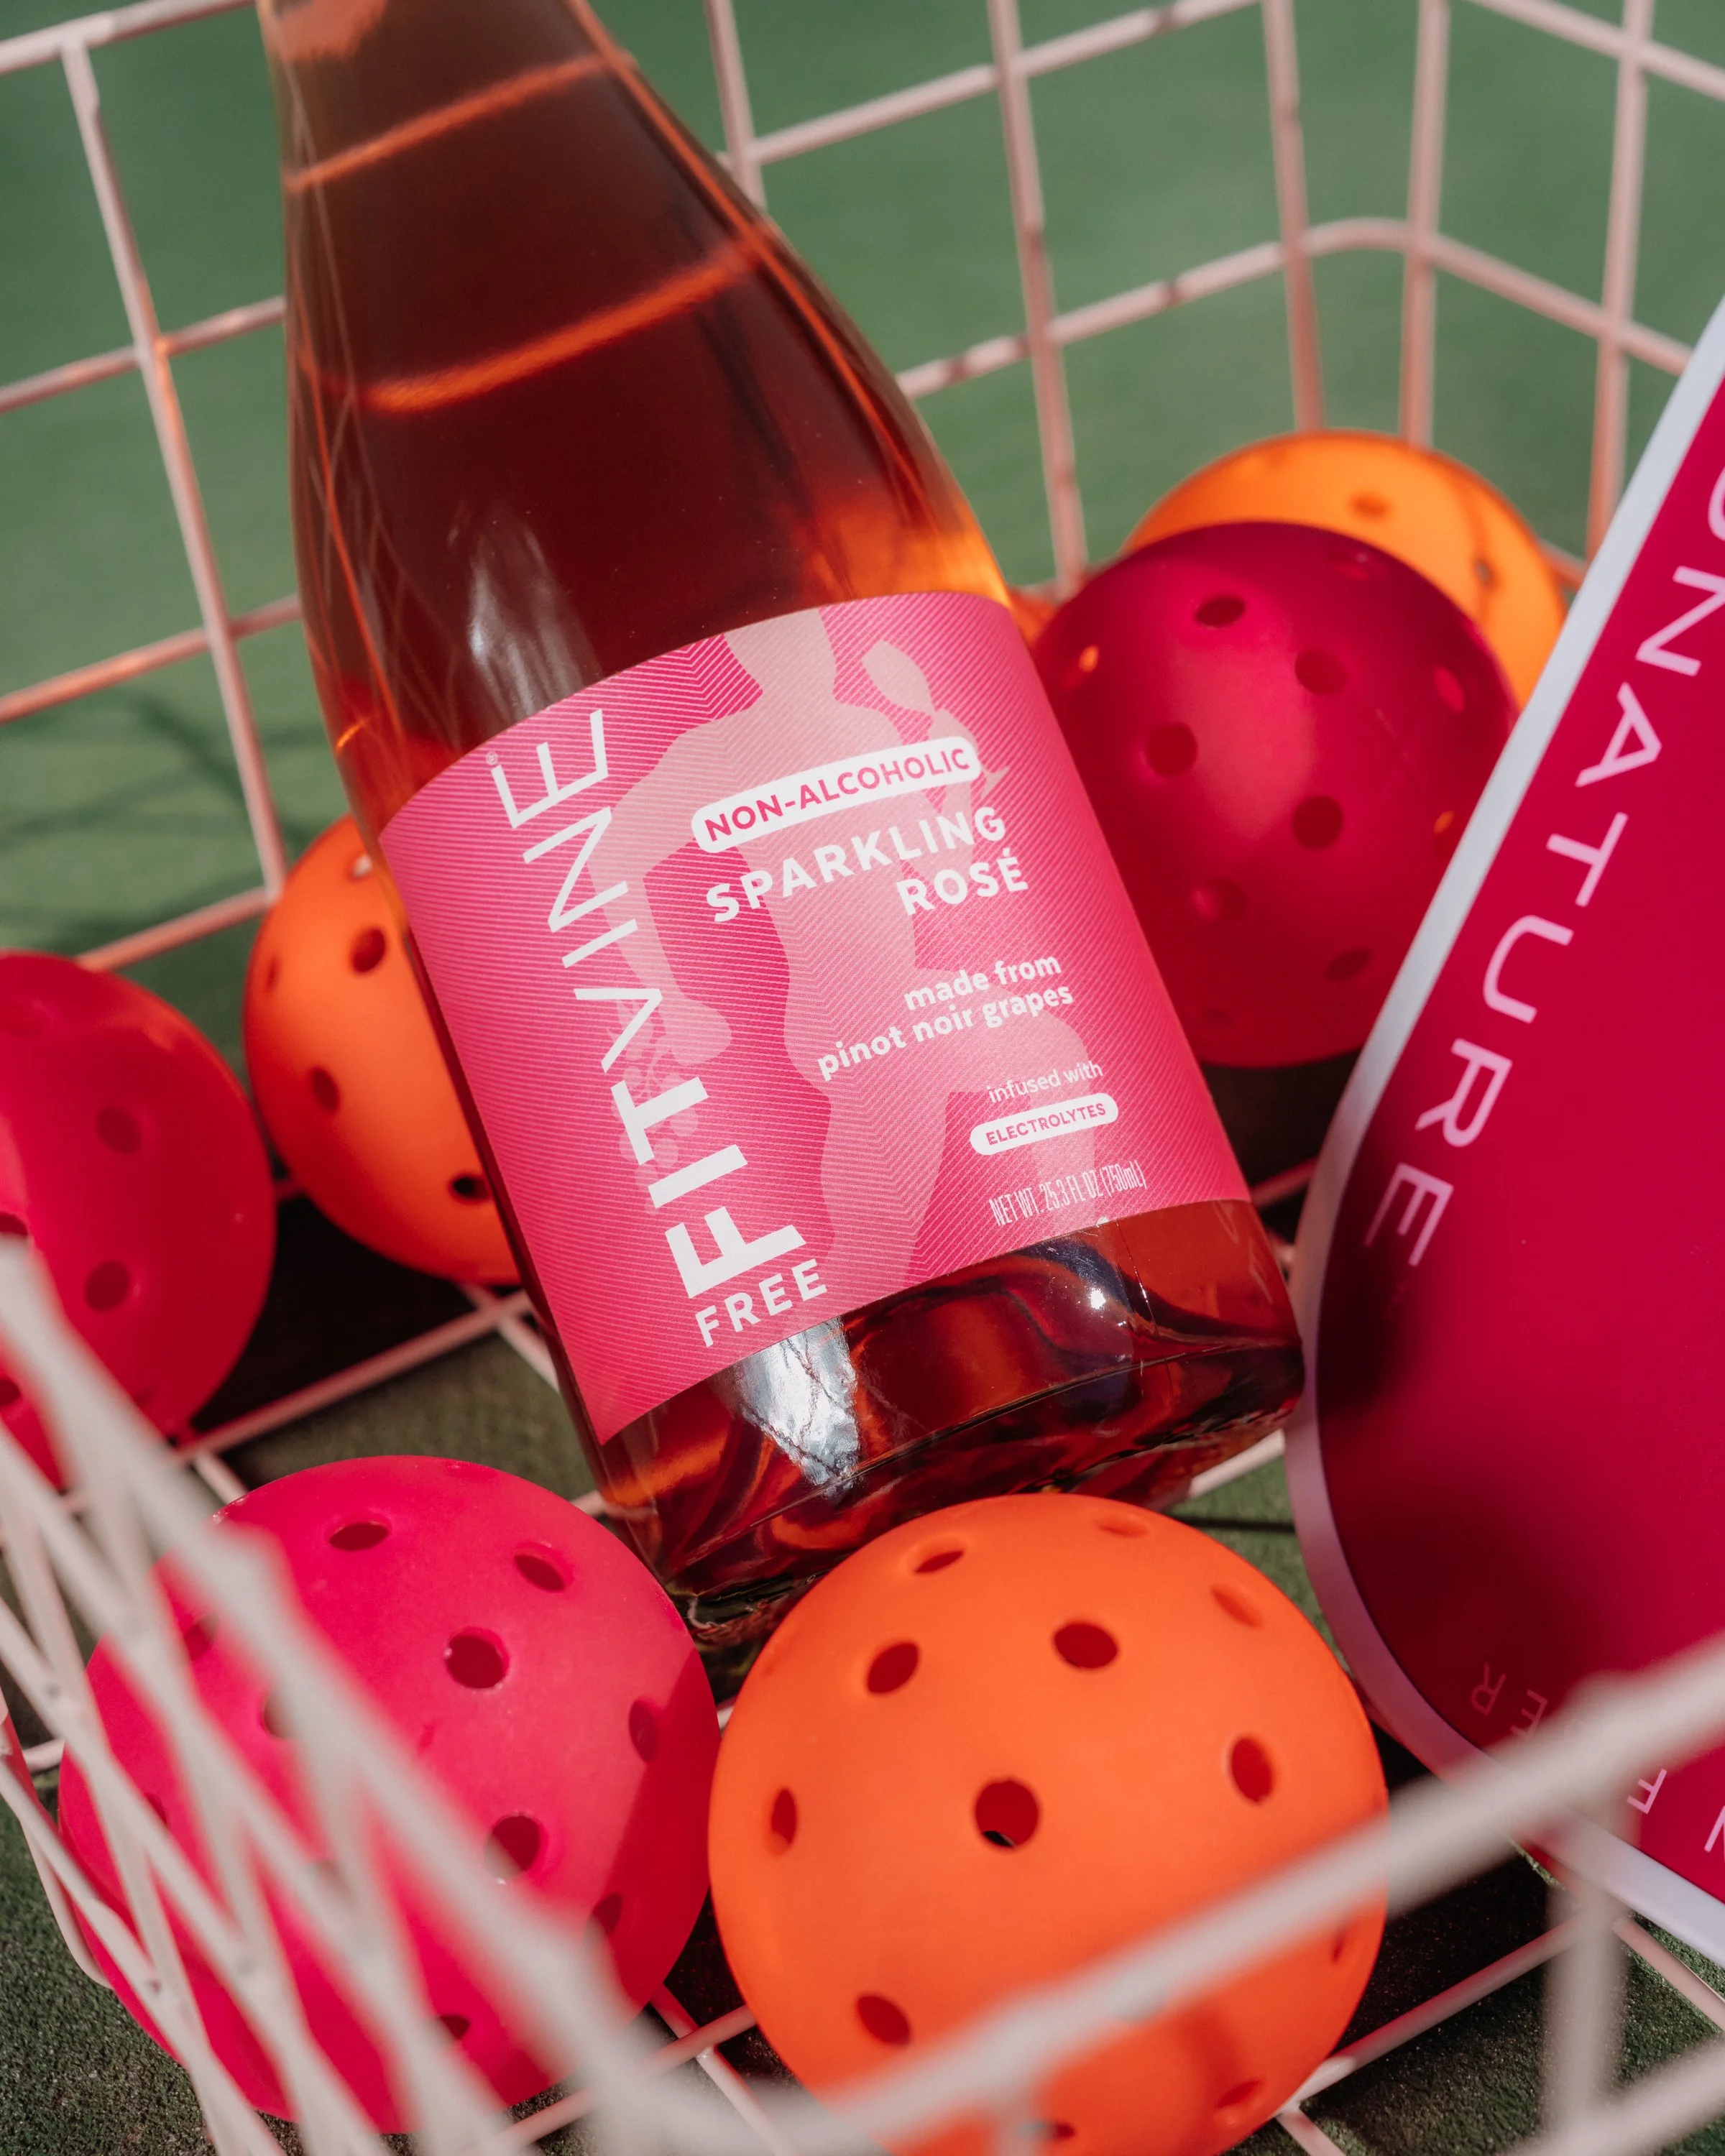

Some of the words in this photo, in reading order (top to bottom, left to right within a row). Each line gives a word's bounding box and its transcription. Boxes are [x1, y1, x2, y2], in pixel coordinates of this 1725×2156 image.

[704, 749, 970, 842] NON-ALCOHOLIC
[706, 806, 1006, 922] SPARKLING
[896, 847, 1029, 916] ROSÉ
[491, 709, 806, 1299] FITVINE
[904, 969, 990, 1010] made
[995, 955, 1062, 985] from
[817, 1026, 907, 1081] pinot
[913, 1005, 975, 1042] noir
[983, 985, 1074, 1028] grapes
[986, 1069, 1061, 1104] infused
[1064, 1061, 1103, 1085] with
[985, 1102, 1107, 1146] ELECTROLYTES
[989, 1194, 1018, 1227] NET
[1013, 1187, 1044, 1218] WT.
[1039, 1179, 1071, 1212] 25.3
[1066, 1175, 1087, 1204] FL
[1082, 1170, 1104, 1199] OZ
[1100, 1159, 1148, 1198] (750mL)
[695, 1258, 827, 1348] FREE
